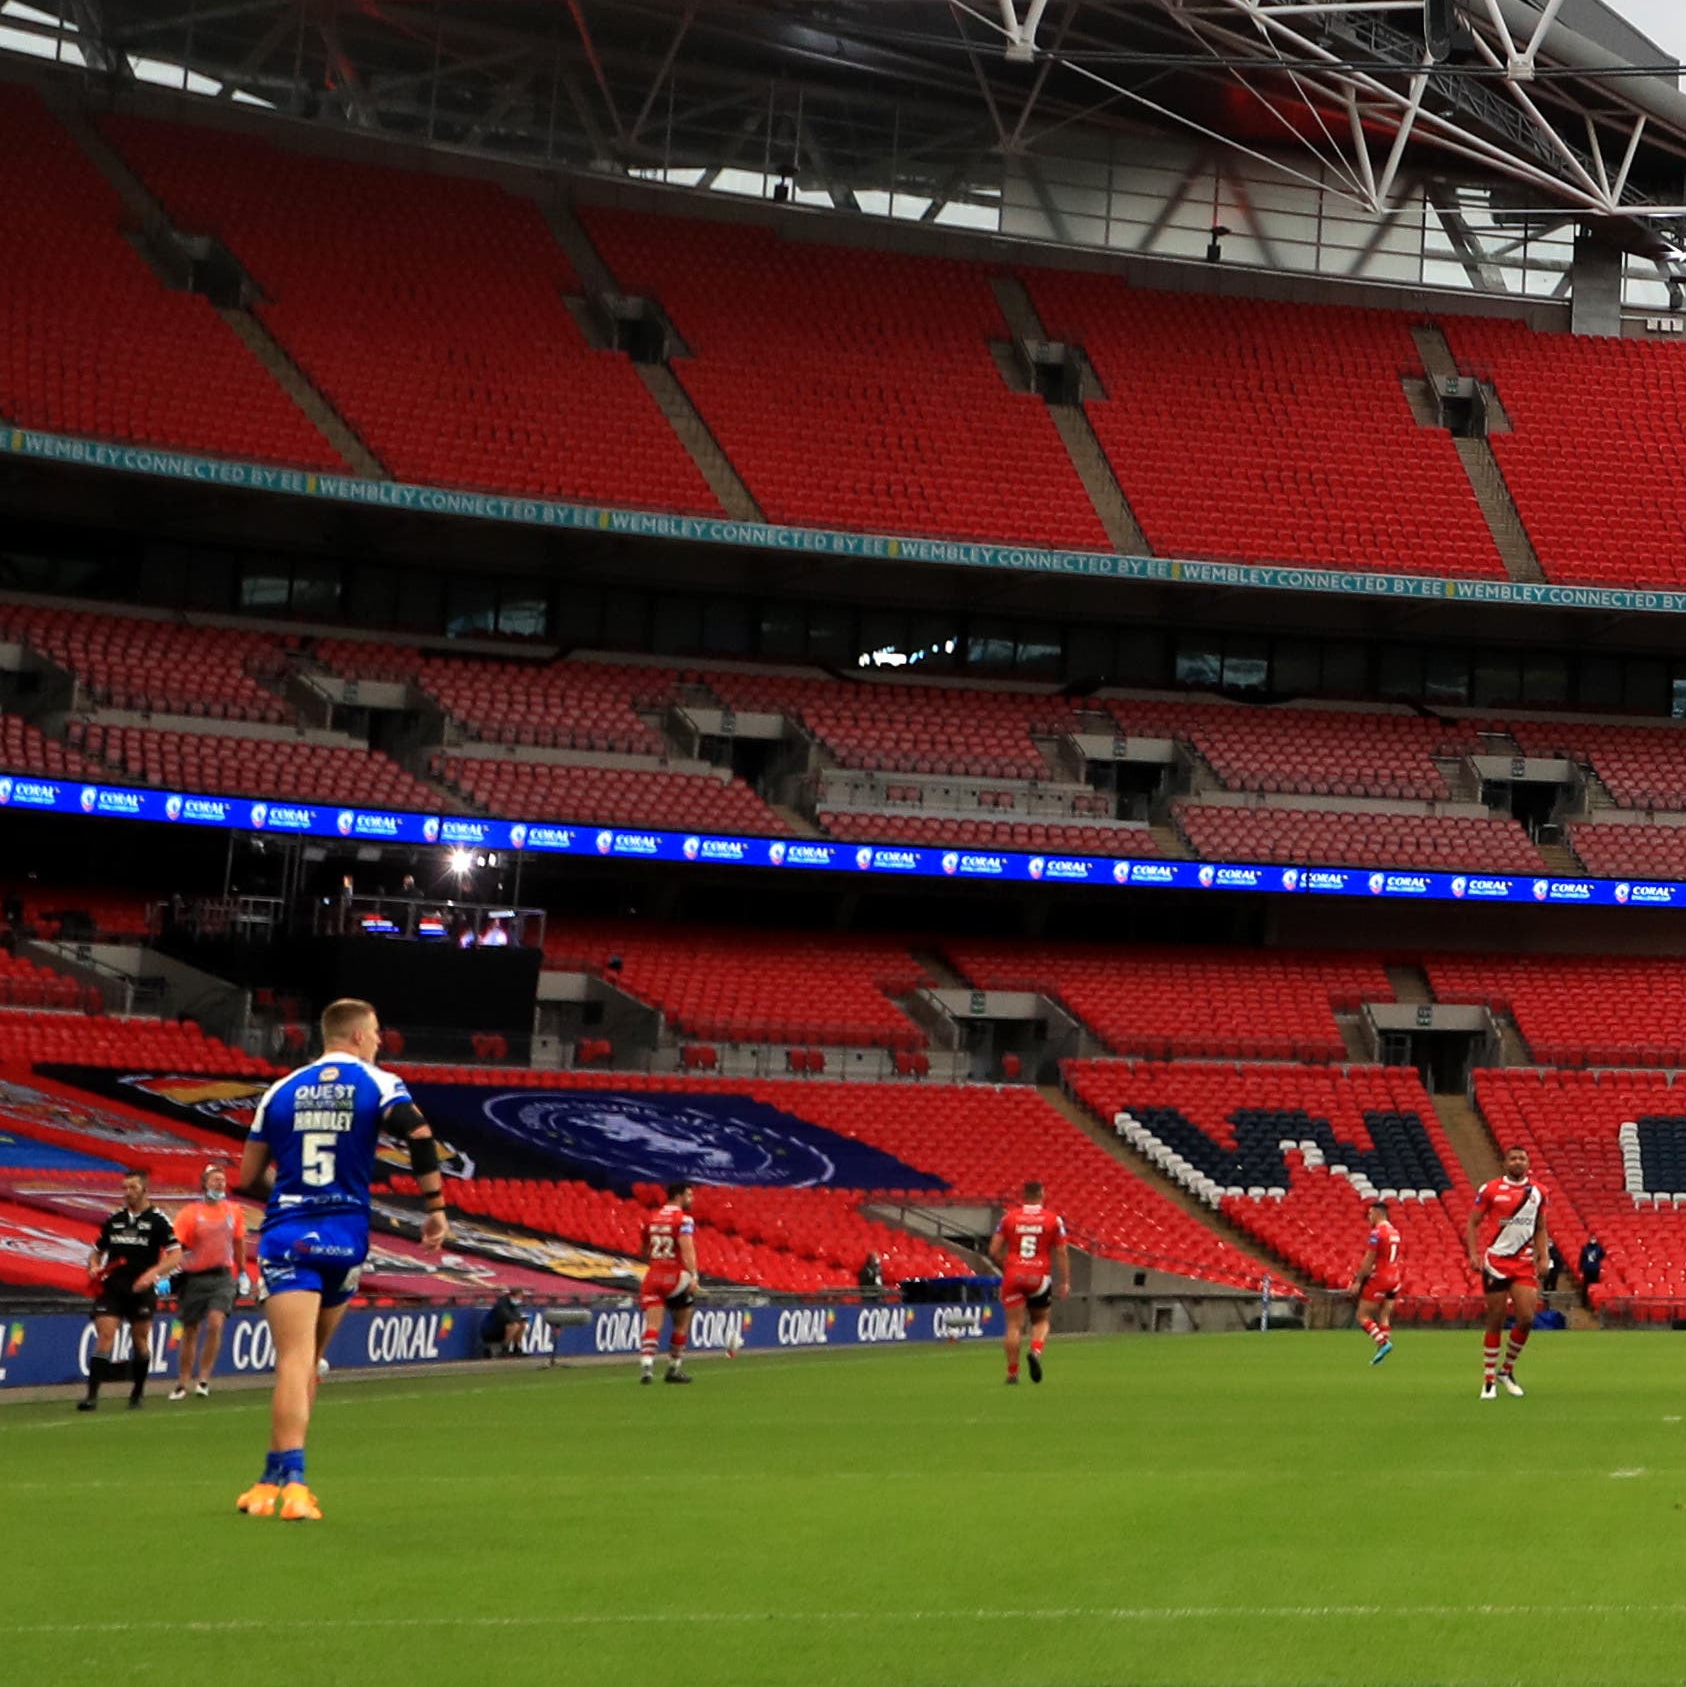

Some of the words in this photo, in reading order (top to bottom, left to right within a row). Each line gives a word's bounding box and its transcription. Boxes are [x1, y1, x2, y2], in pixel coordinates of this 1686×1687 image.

[611, 512, 704, 538] WEMBLEY
[710, 522, 826, 550] CONNECTED
[832, 534, 857, 551] BY
[861, 537, 883, 553] EE
[901, 541, 993, 561] WEMBLEY
[997, 551, 1112, 572] CONNECTED
[1118, 558, 1141, 575] BY
[1146, 561, 1168, 577] EE
[1181, 564, 1273, 585] WEMBLEY
[1277, 570, 1387, 592] CONNECTED
[1393, 578, 1414, 594] BY
[1421, 579, 1442, 595] EE
[1457, 581, 1545, 601] WEMBLEY
[1549, 588, 1657, 608] CONNECTED
[1663, 595, 1686, 611] BY
[294, 1084, 355, 1101] QUEST
[302, 1133, 338, 1187] 5
[649, 1235, 677, 1259] 22
[367, 1314, 440, 1363] CORAL
[595, 1310, 642, 1353] CORA
[690, 1310, 745, 1349] CORAL
[777, 1309, 828, 1345] CORAL
[857, 1307, 907, 1342] CORAL
